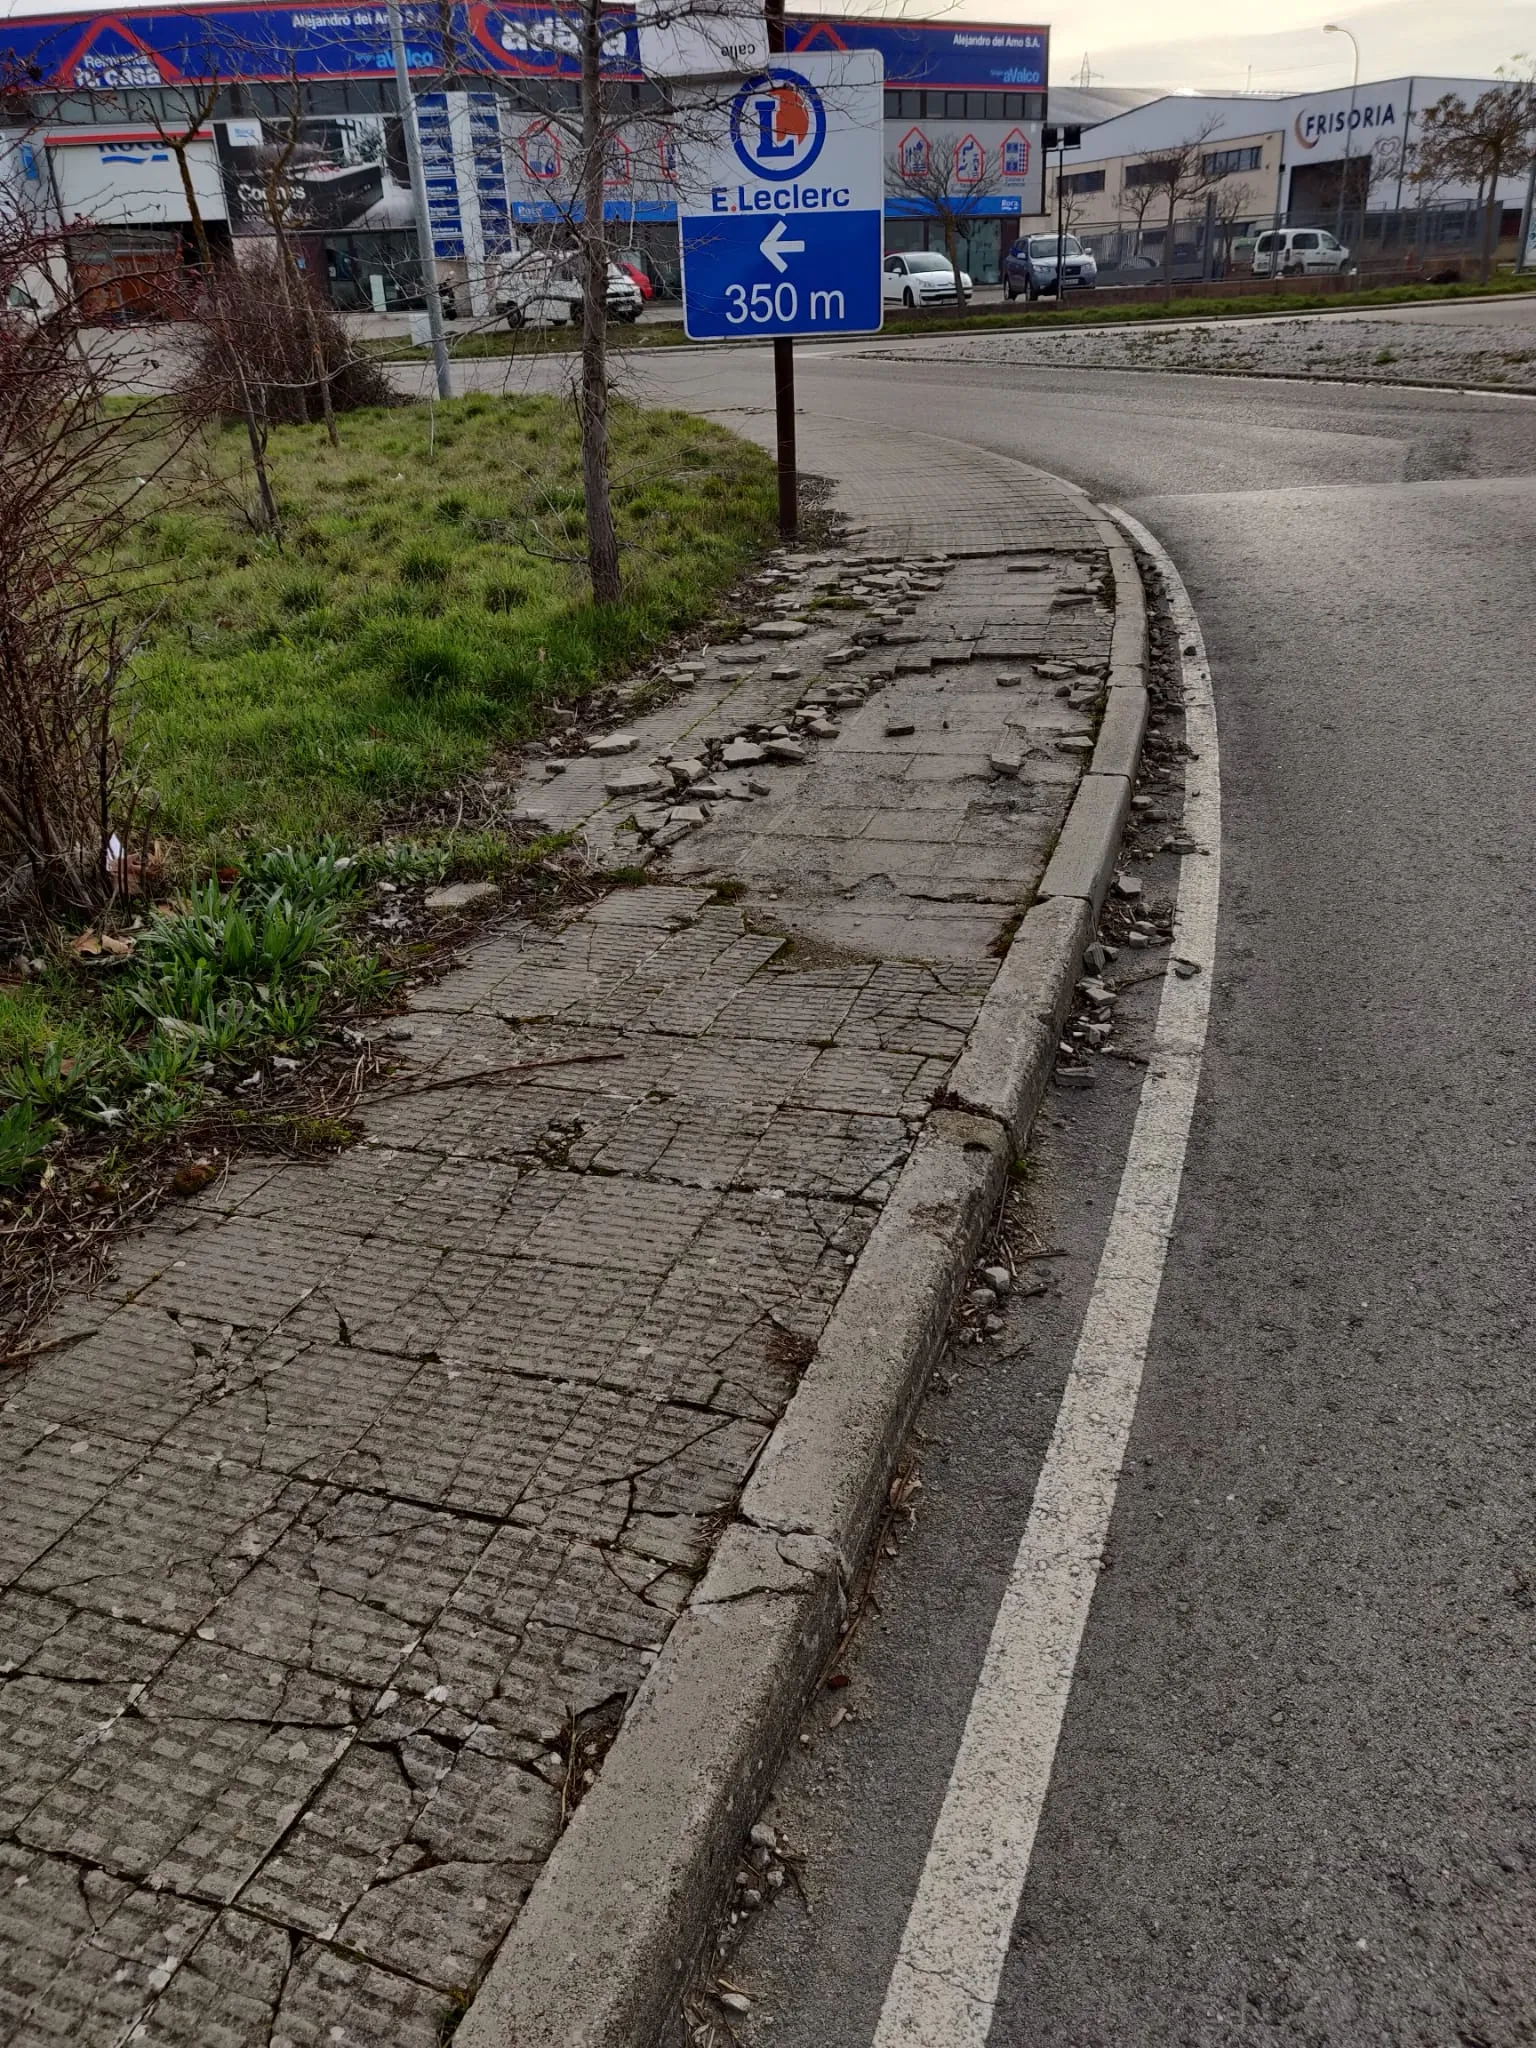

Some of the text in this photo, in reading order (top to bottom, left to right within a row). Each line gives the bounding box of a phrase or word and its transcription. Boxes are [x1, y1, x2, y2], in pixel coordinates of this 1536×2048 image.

[292, 12, 351, 29] Alejandro
[354, 12, 372, 26] del
[953, 33, 1041, 48] Alejandro del Amo S.A.
[721, 43, 756, 61] calle
[104, 66, 161, 86] casa
[1305, 103, 1395, 137] FRISORIA
[711, 184, 850, 213] E.Leclerc
[724, 282, 845, 323] 350 m
